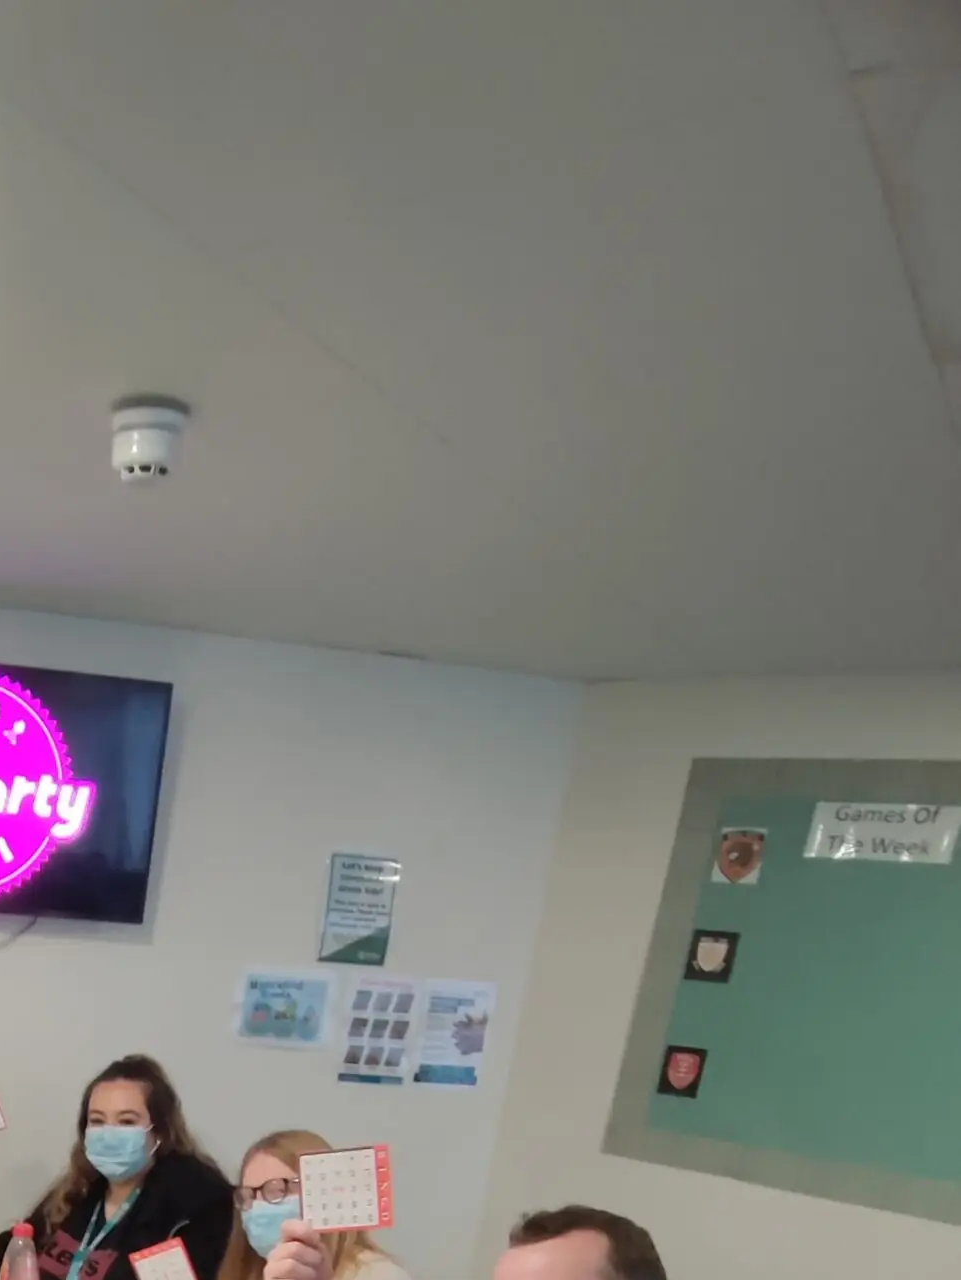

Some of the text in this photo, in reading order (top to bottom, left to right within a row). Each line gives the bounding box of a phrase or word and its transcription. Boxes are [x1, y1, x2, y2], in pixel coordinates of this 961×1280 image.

[834, 805, 940, 825] Games Of
[872, 837, 930, 856] Week
